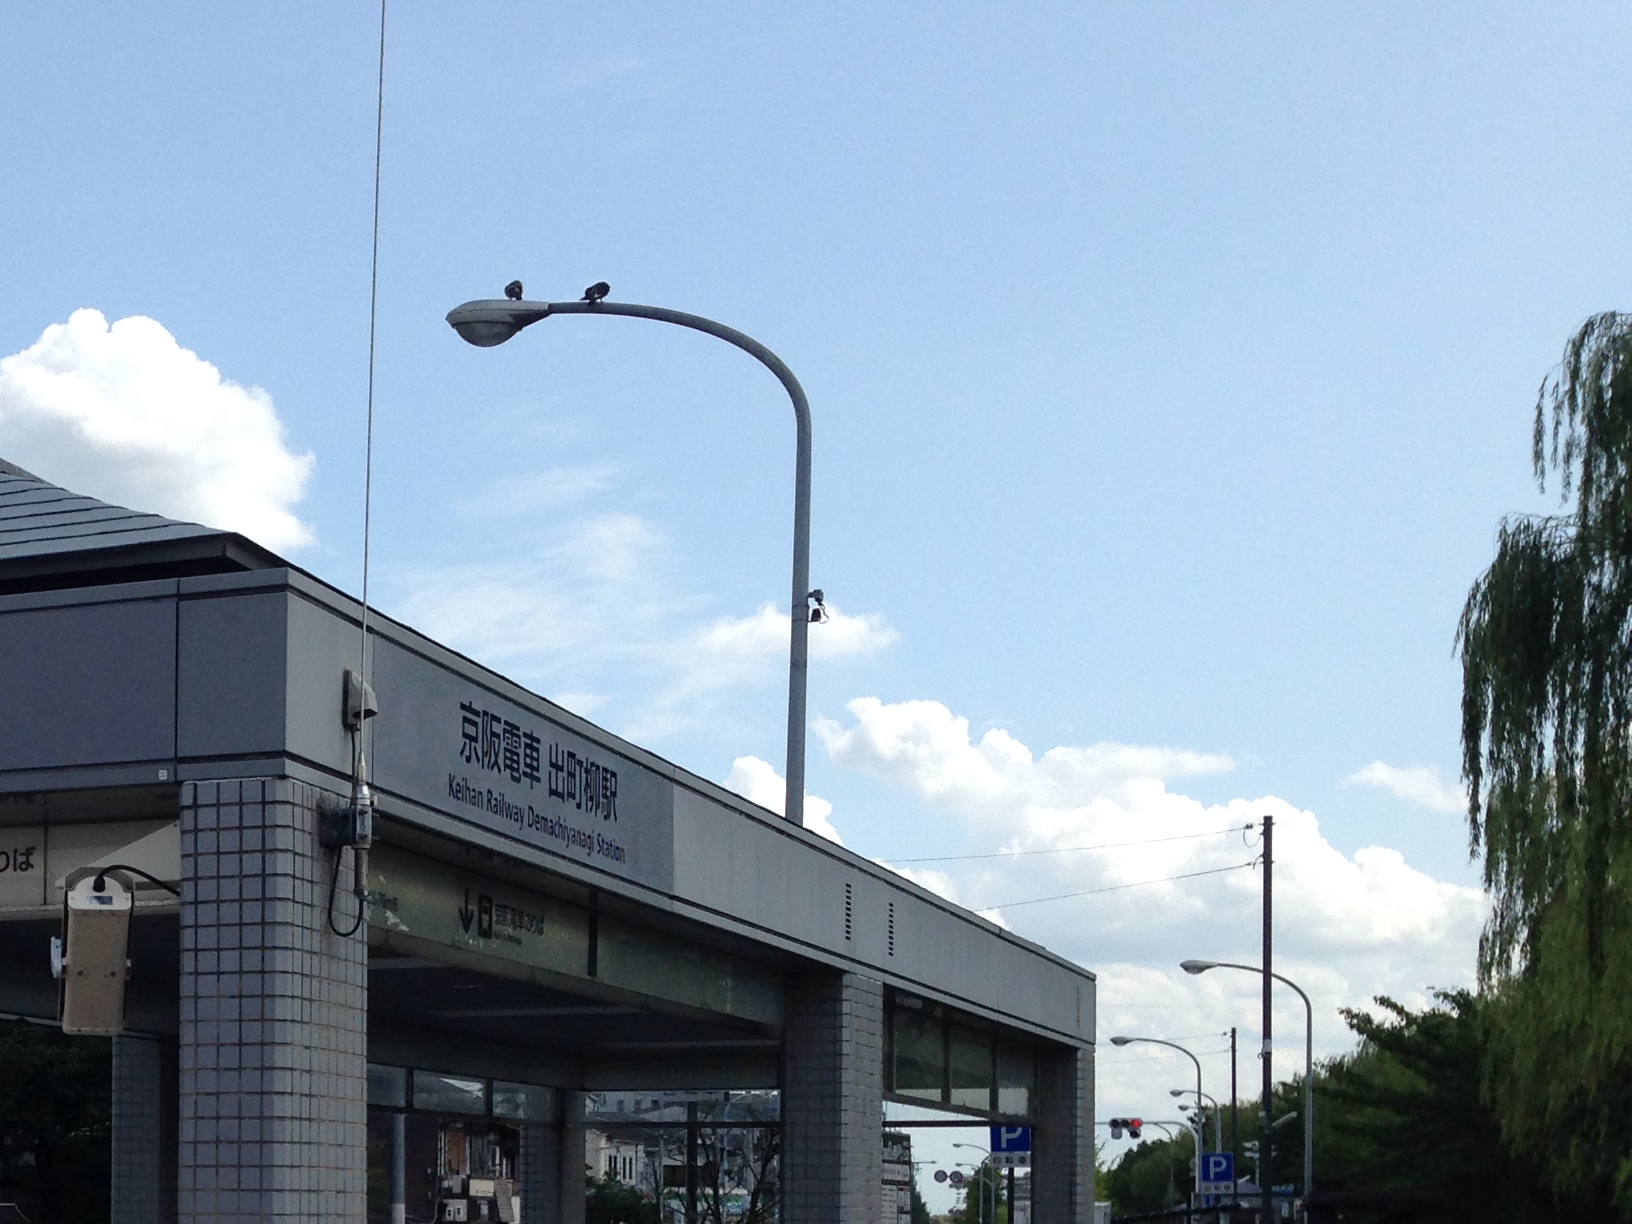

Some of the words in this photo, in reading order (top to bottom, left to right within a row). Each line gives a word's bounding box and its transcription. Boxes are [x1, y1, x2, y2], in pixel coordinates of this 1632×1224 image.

[459, 700, 541, 790] 京阪電車
[548, 742, 618, 823] 出町柳駅
[448, 773, 483, 809] Keihan
[486, 788, 525, 830] Railway
[527, 805, 595, 856] Demachiyanagi
[596, 832, 626, 864] Station
[1001, 1126, 1023, 1148] P
[1209, 1156, 1227, 1180] P
